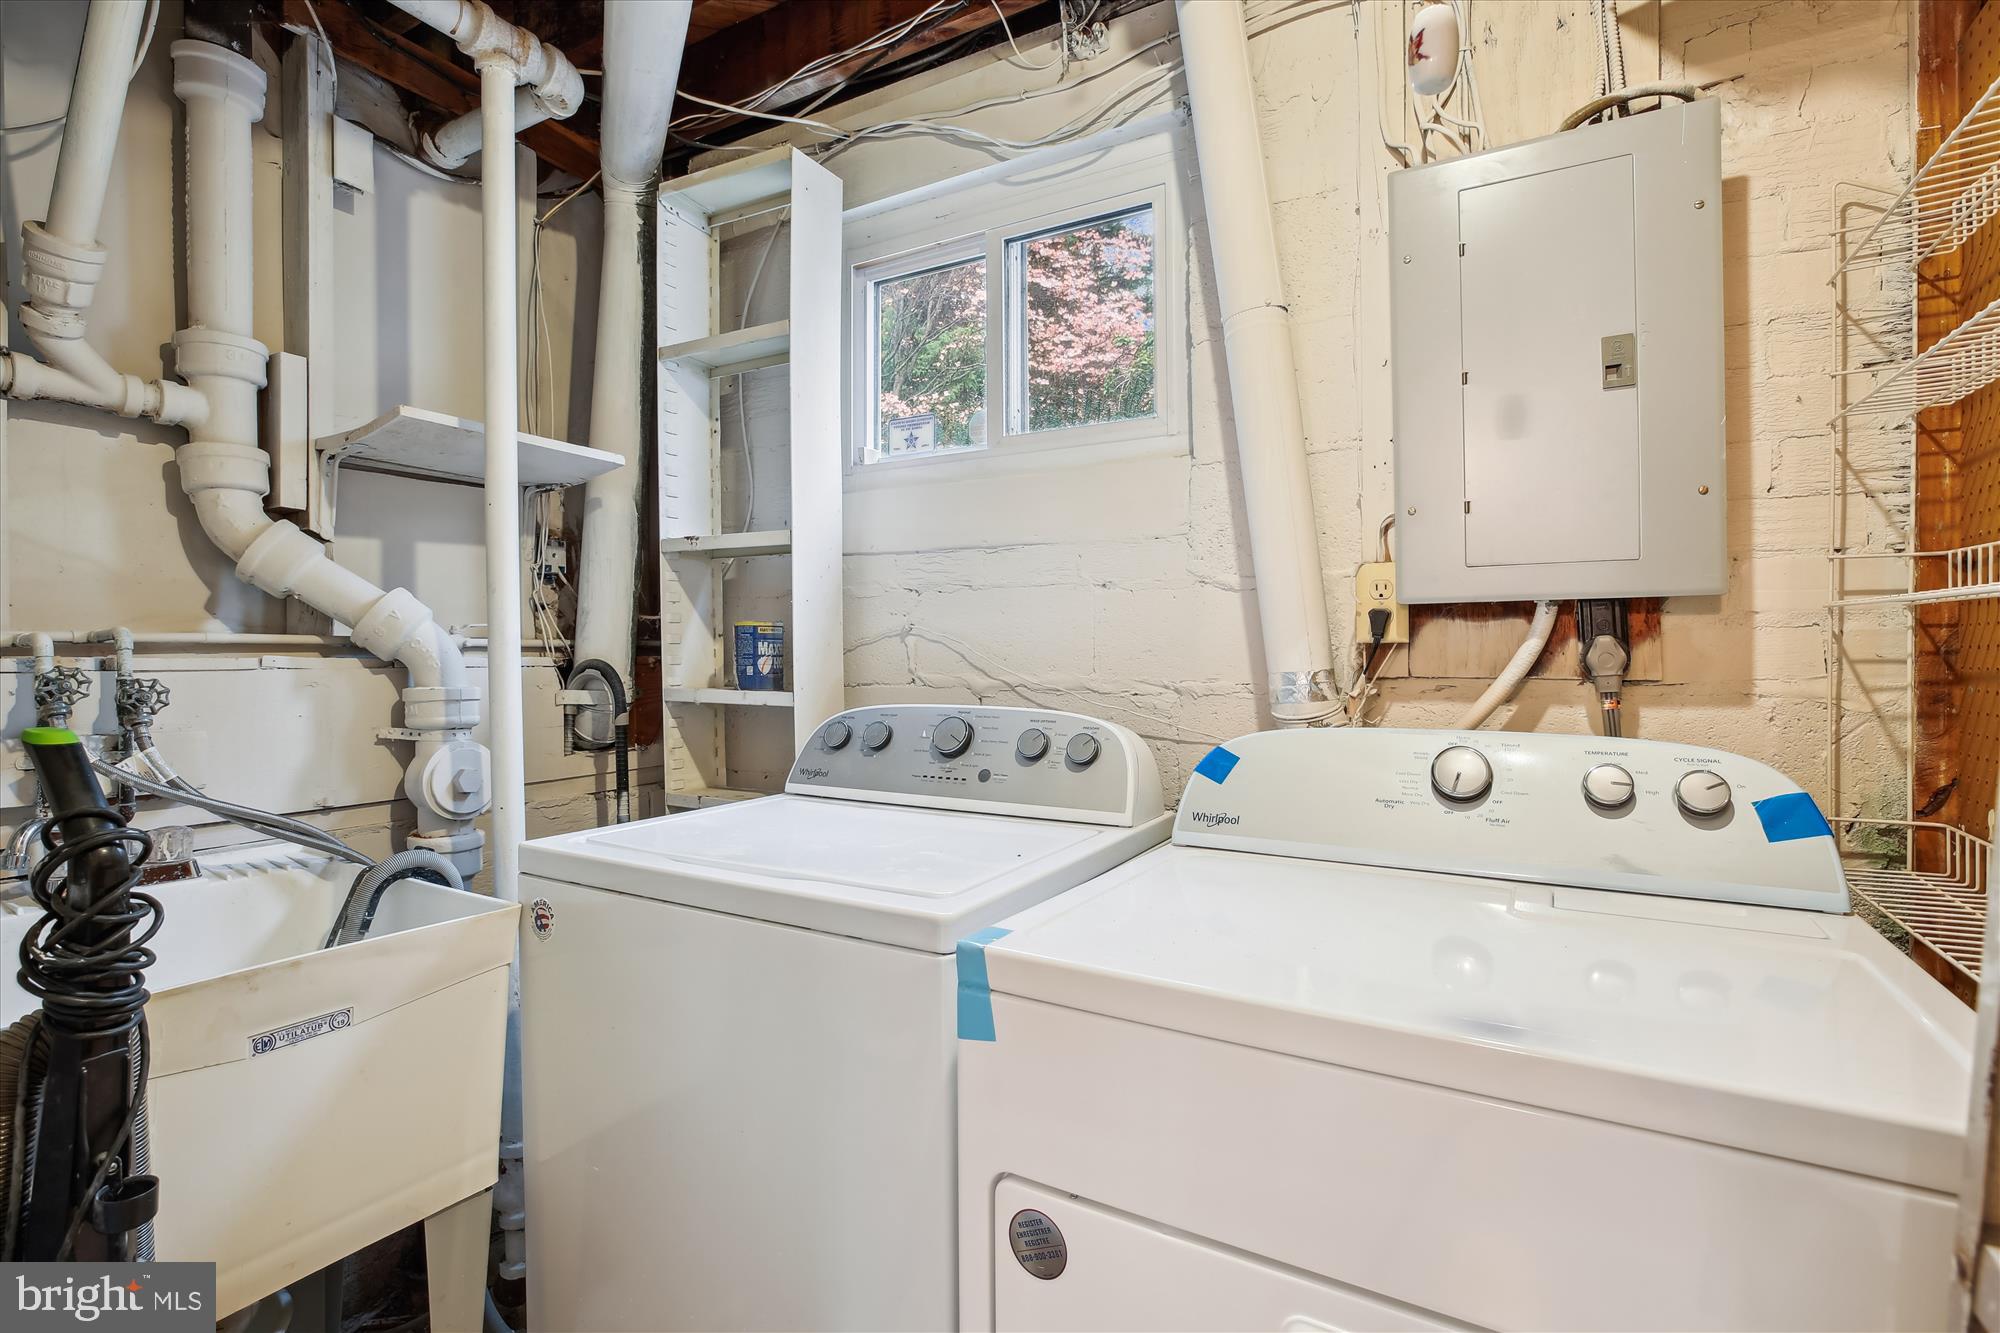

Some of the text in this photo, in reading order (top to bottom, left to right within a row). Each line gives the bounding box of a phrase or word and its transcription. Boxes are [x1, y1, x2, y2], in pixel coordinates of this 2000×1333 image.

[800, 768, 829, 779] Whirlpool
[1192, 811, 1240, 827] Whirlpool
[1018, 1218, 1044, 1229] REGISTER
